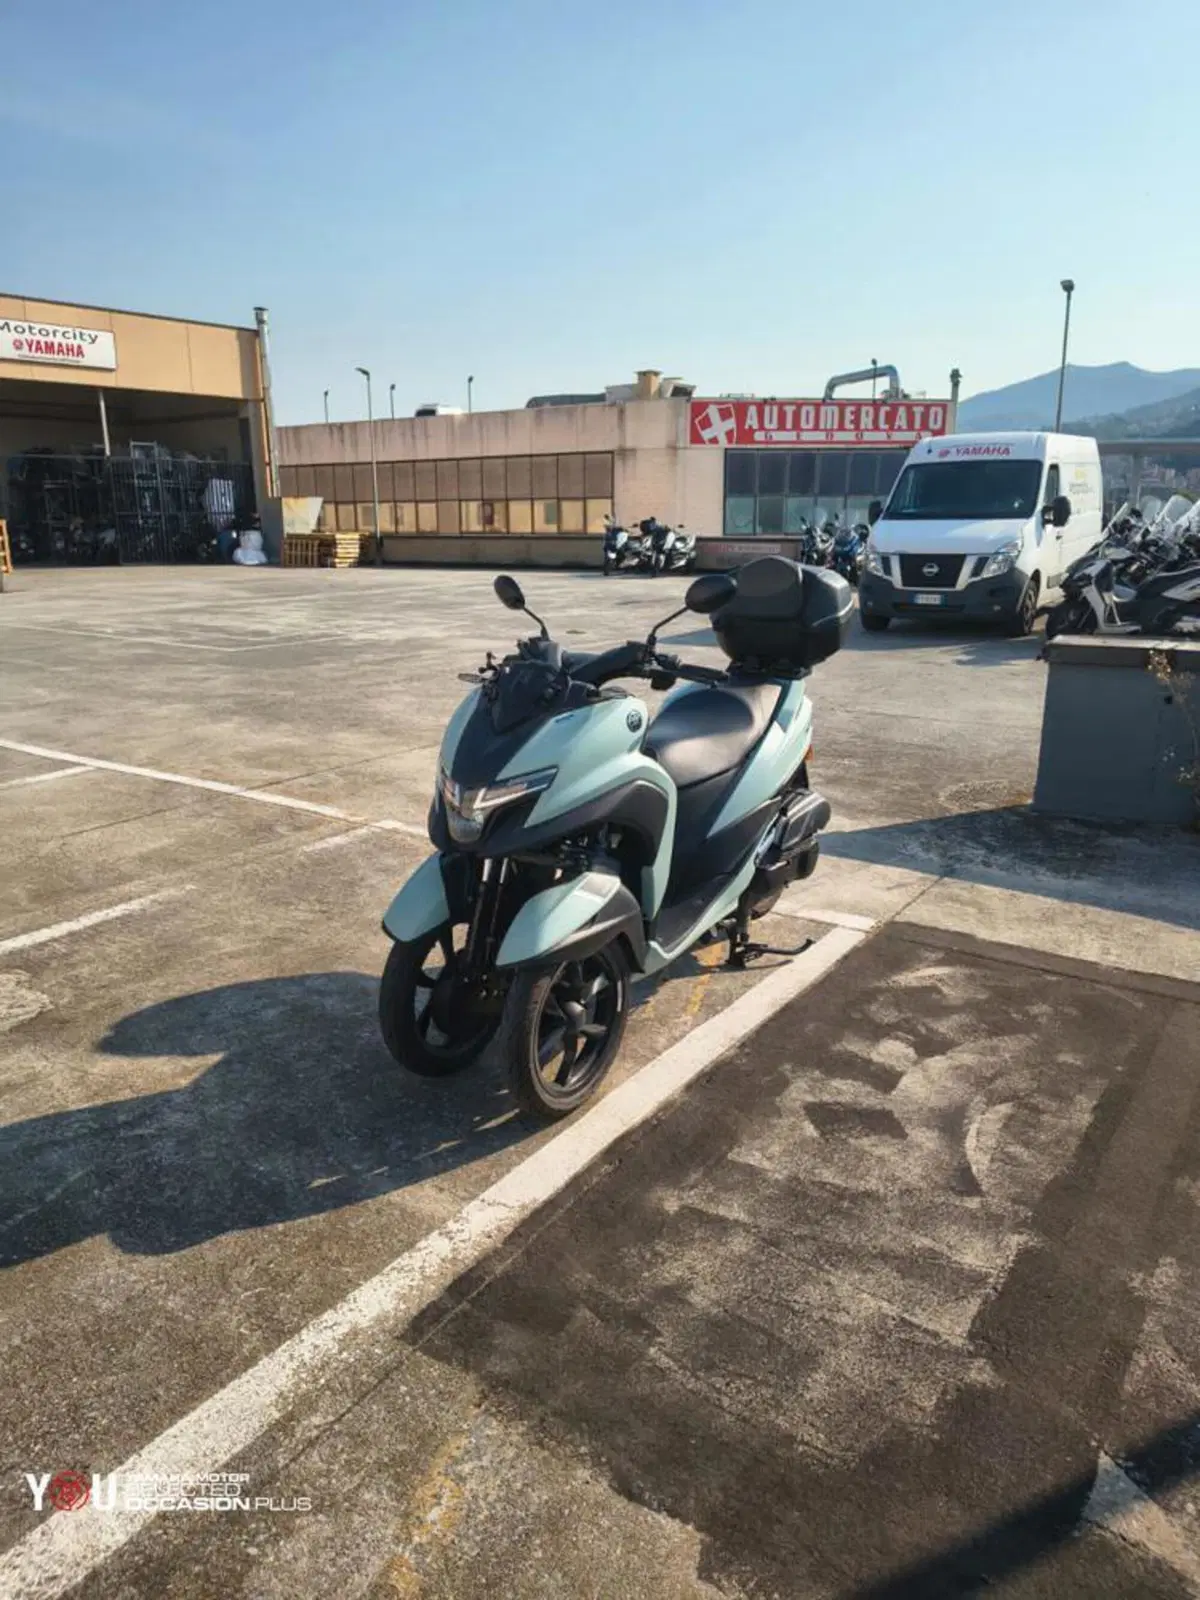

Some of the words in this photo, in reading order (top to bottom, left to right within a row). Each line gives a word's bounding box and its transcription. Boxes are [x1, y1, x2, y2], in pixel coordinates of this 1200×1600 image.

[0, 321, 98, 345] Motorcity
[25, 338, 85, 358] YAMAHA
[744, 404, 943, 430] AUTOMERCATO
[956, 445, 1011, 456] YAMAHA
